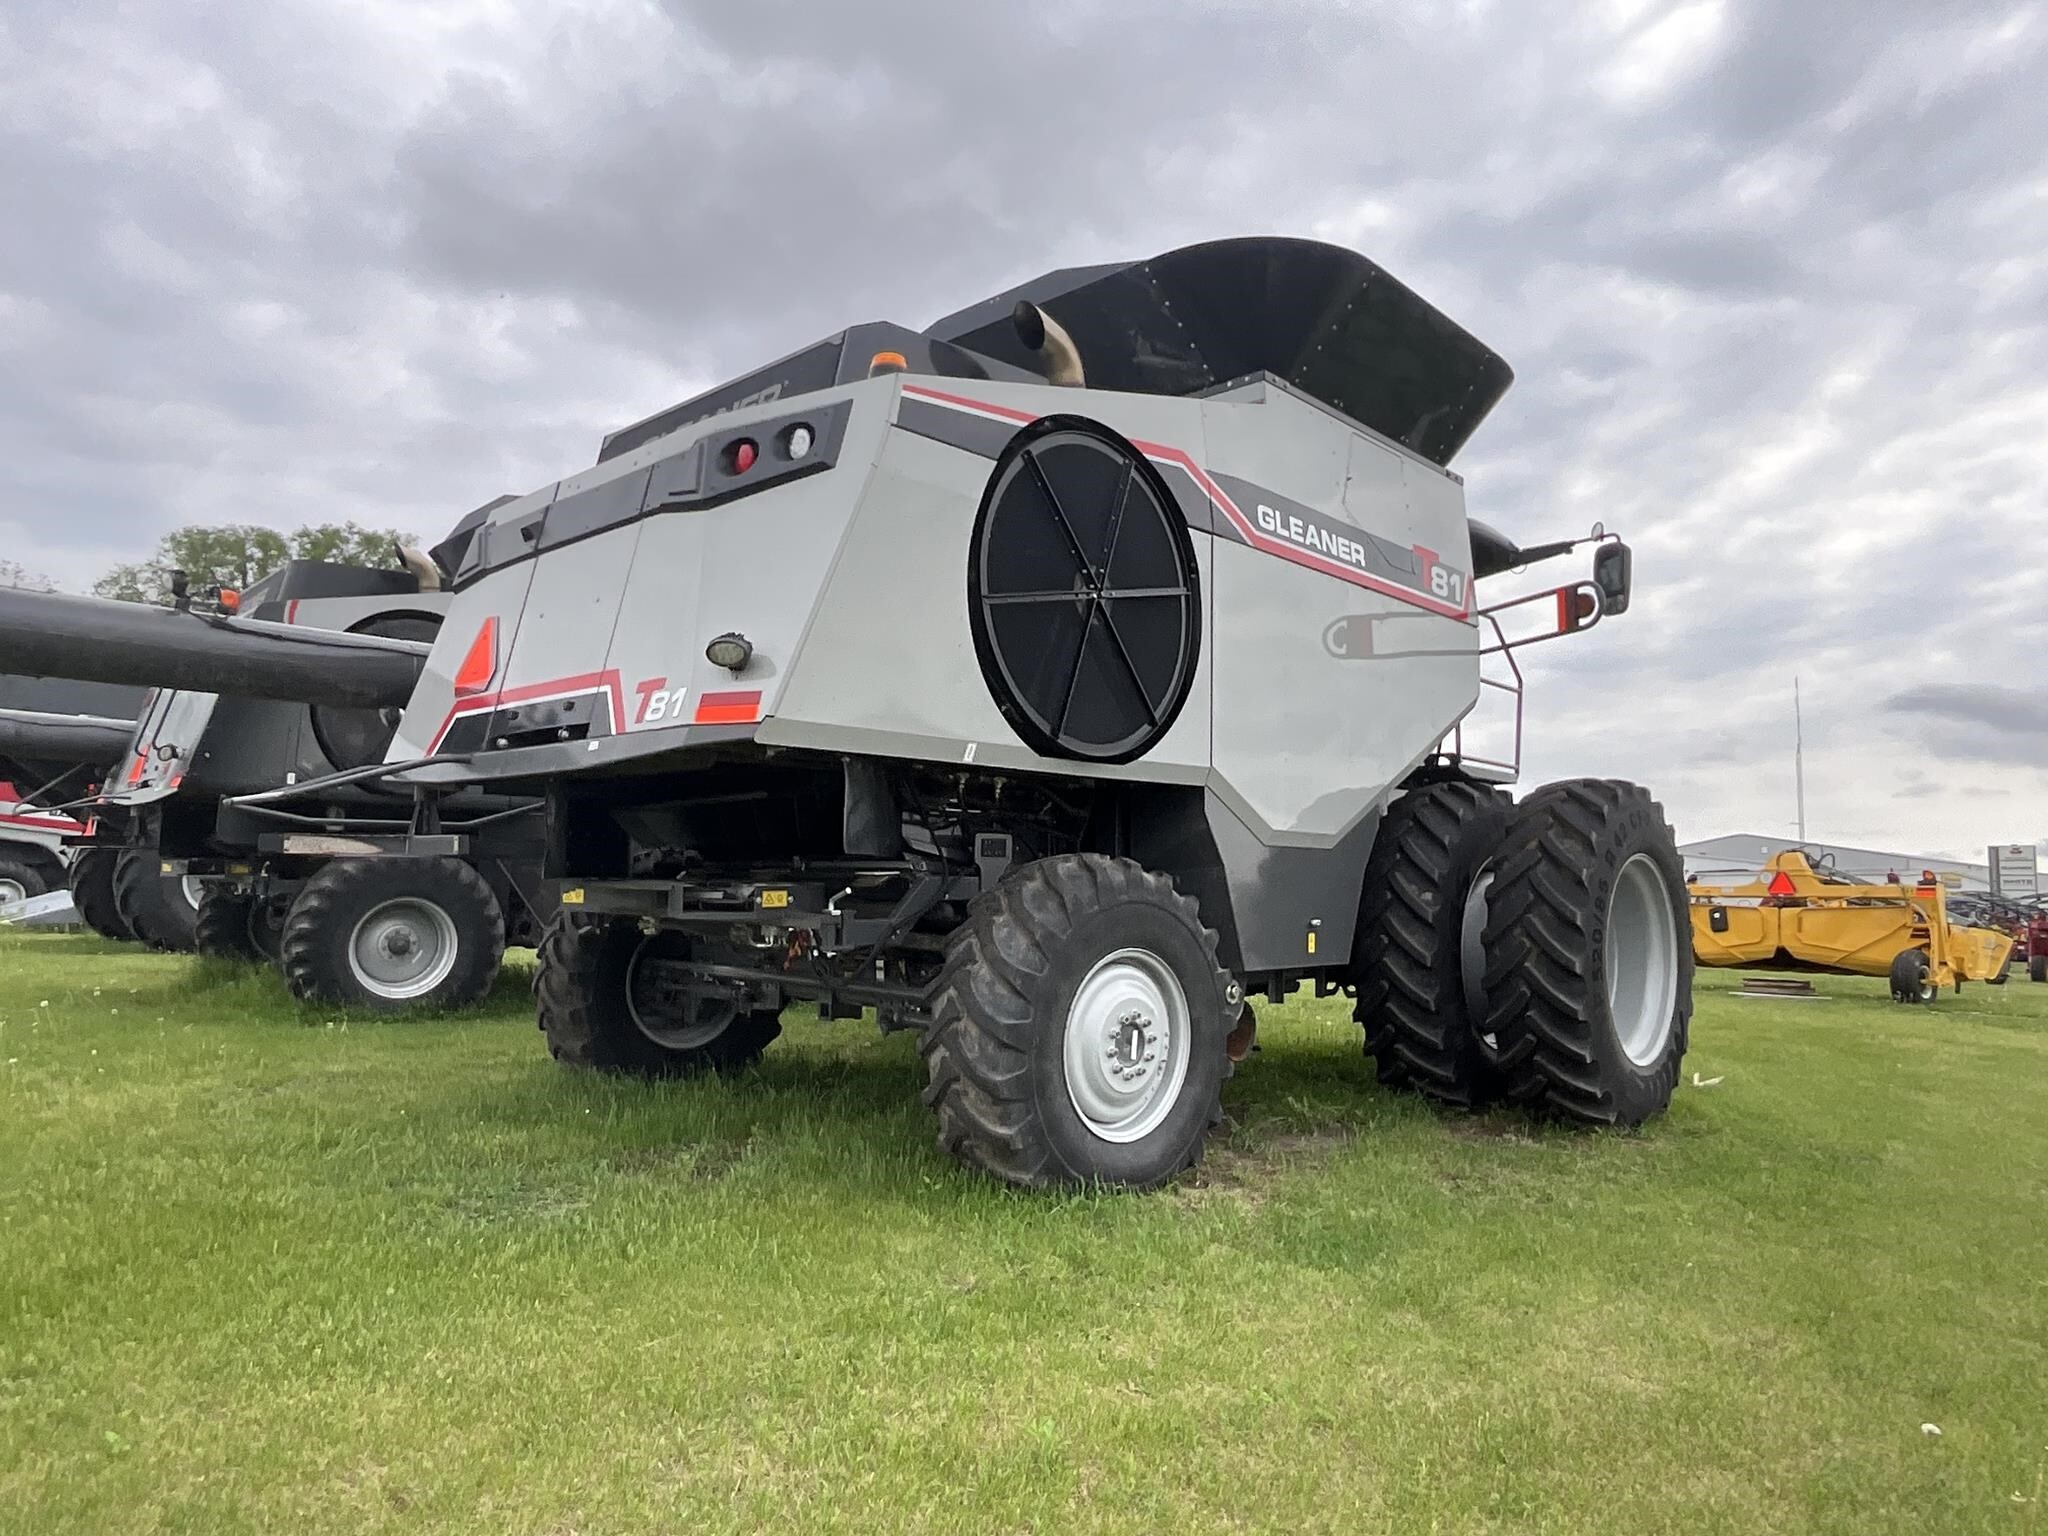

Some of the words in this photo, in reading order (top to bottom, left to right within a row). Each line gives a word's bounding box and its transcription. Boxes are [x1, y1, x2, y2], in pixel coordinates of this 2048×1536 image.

[1257, 504, 1366, 567] GLEANER
[1412, 545, 1461, 602] T81
[635, 677, 688, 724] T81
